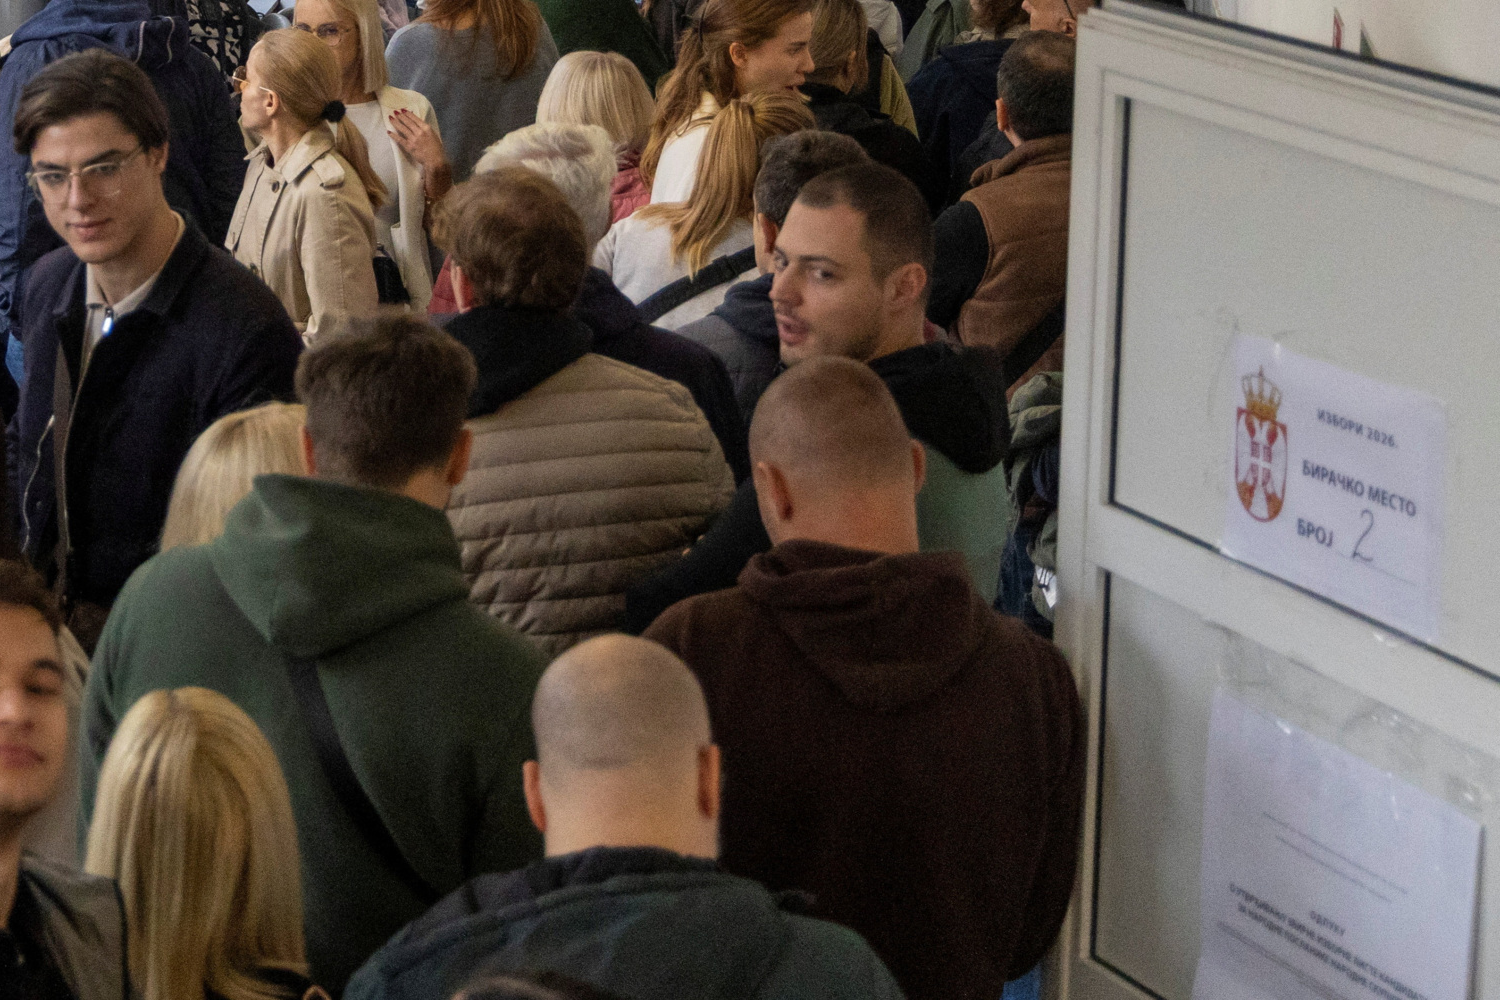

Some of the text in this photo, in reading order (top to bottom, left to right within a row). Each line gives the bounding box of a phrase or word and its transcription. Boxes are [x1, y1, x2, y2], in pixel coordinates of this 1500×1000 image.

[1317, 408, 1363, 435] ИЗБОРИ
[1302, 459, 1417, 517] БИРАЧКО МЕСТО
[1297, 509, 1375, 562] БРОЈ 2
